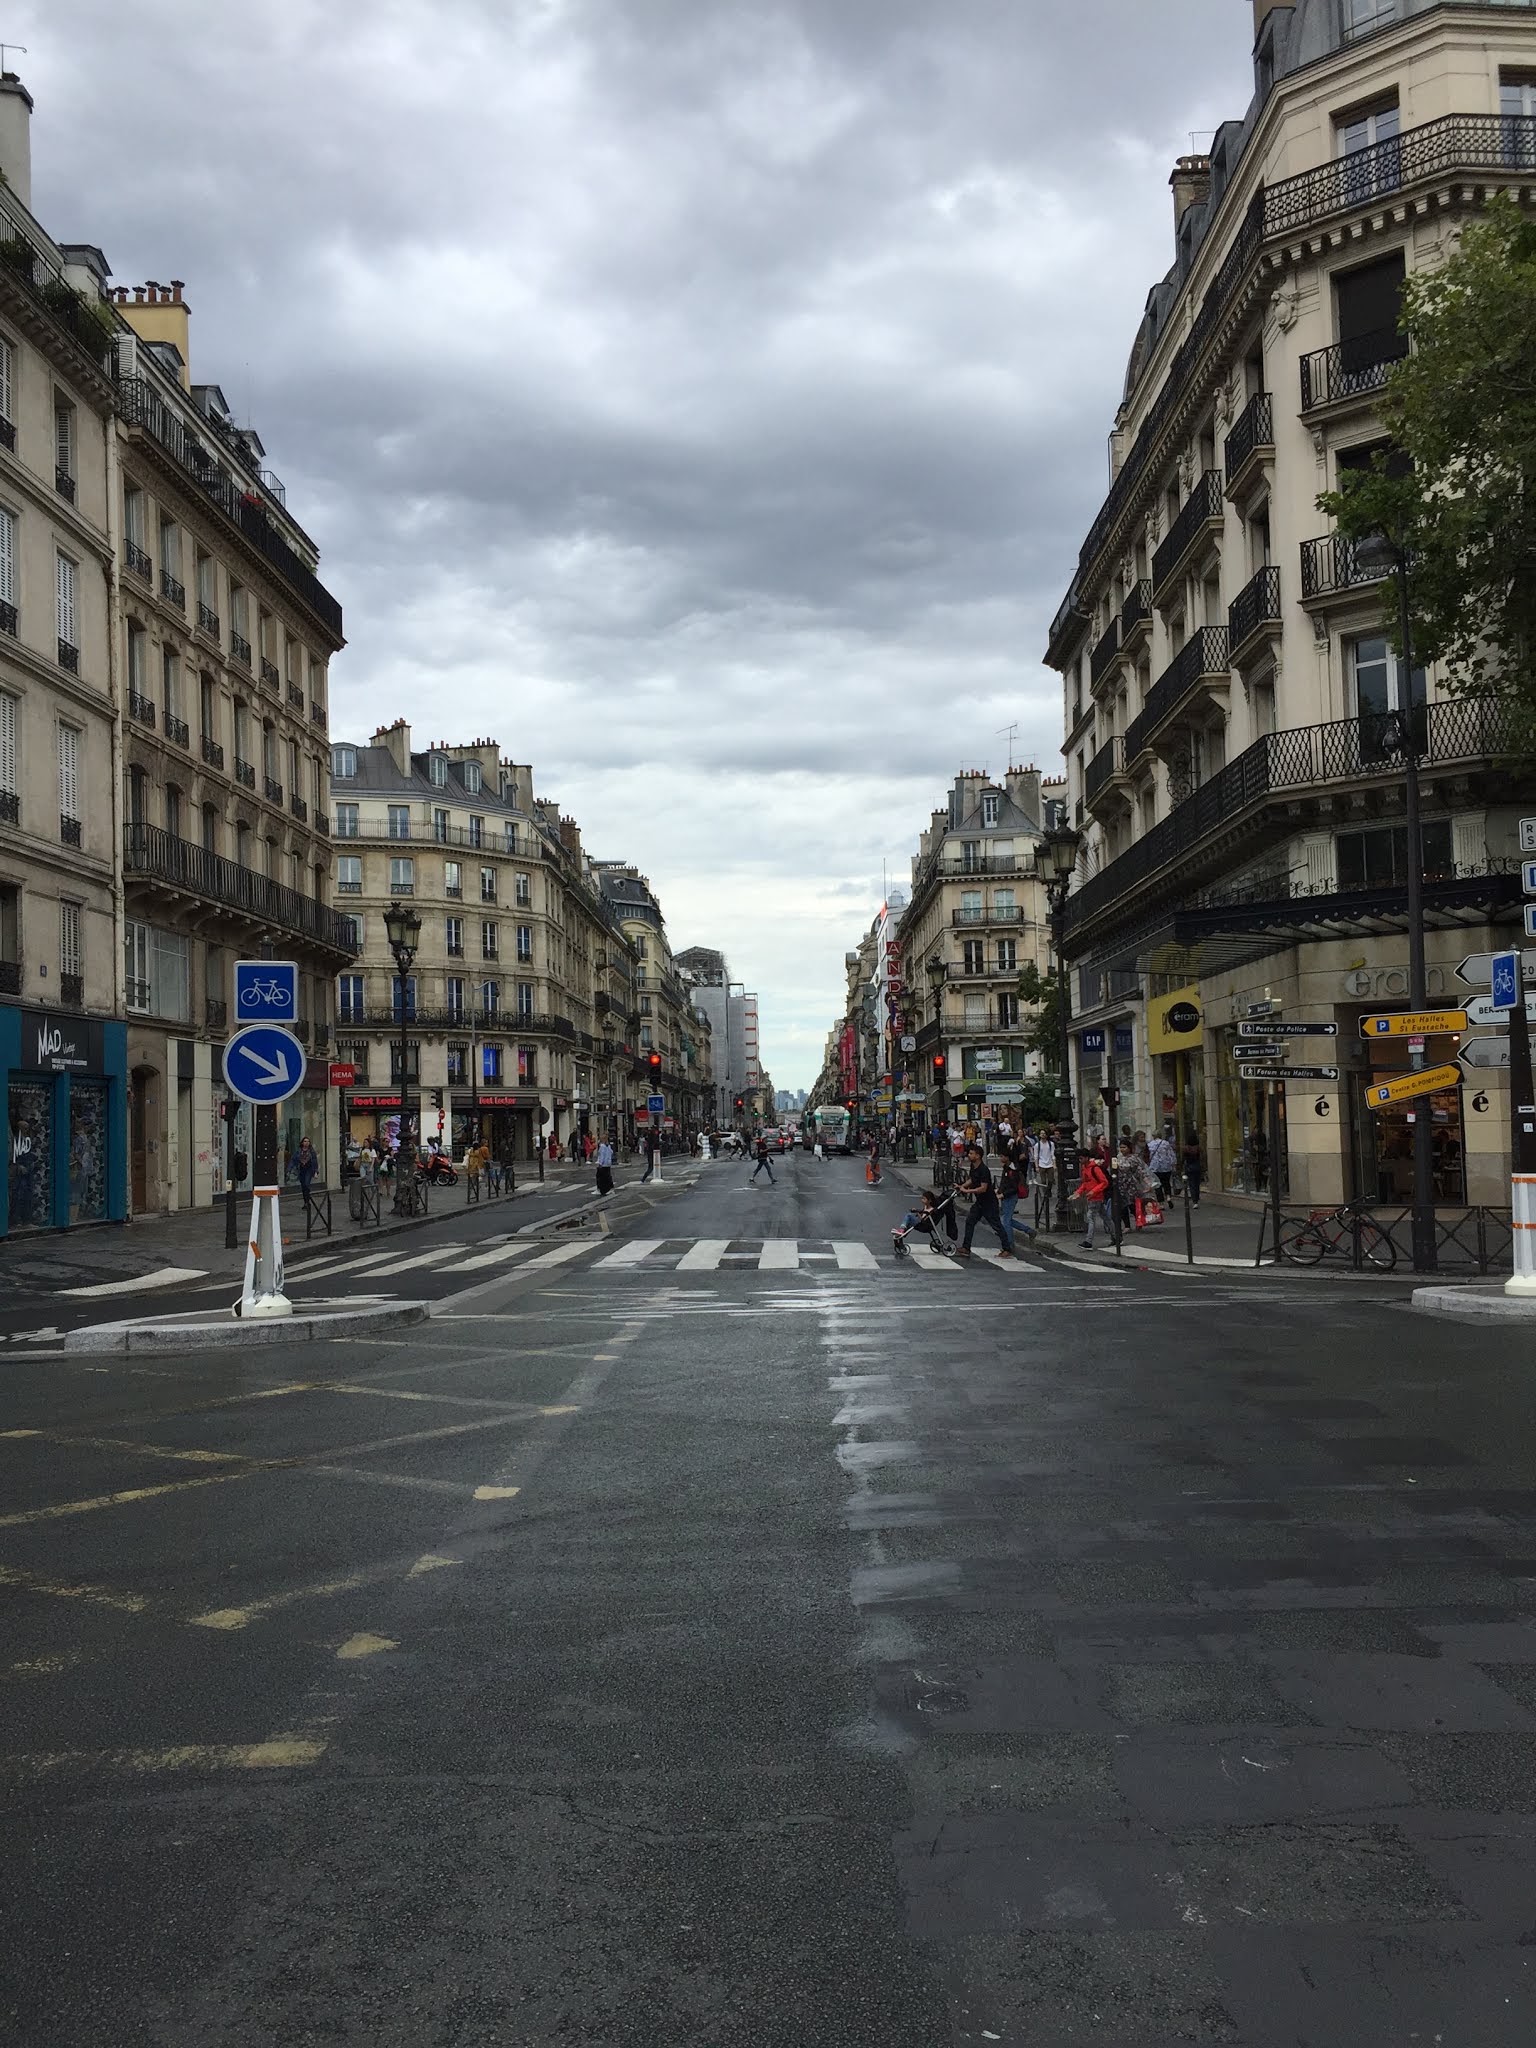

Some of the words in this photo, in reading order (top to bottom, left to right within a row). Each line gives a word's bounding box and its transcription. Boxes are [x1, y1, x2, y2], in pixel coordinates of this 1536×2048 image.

[1174, 1011, 1199, 1021] éram
[1286, 1025, 1307, 1033] Police
[1412, 1024, 1450, 1032] Eustache
[38, 1016, 61, 1065] MAD
[1086, 1036, 1101, 1046] GAP
[332, 1071, 353, 1079] HEMA
[1418, 1073, 1450, 1086] POMPIDOU
[353, 1097, 374, 1106] Foot
[375, 1097, 402, 1106] Locke
[13, 1129, 32, 1164] MAD
